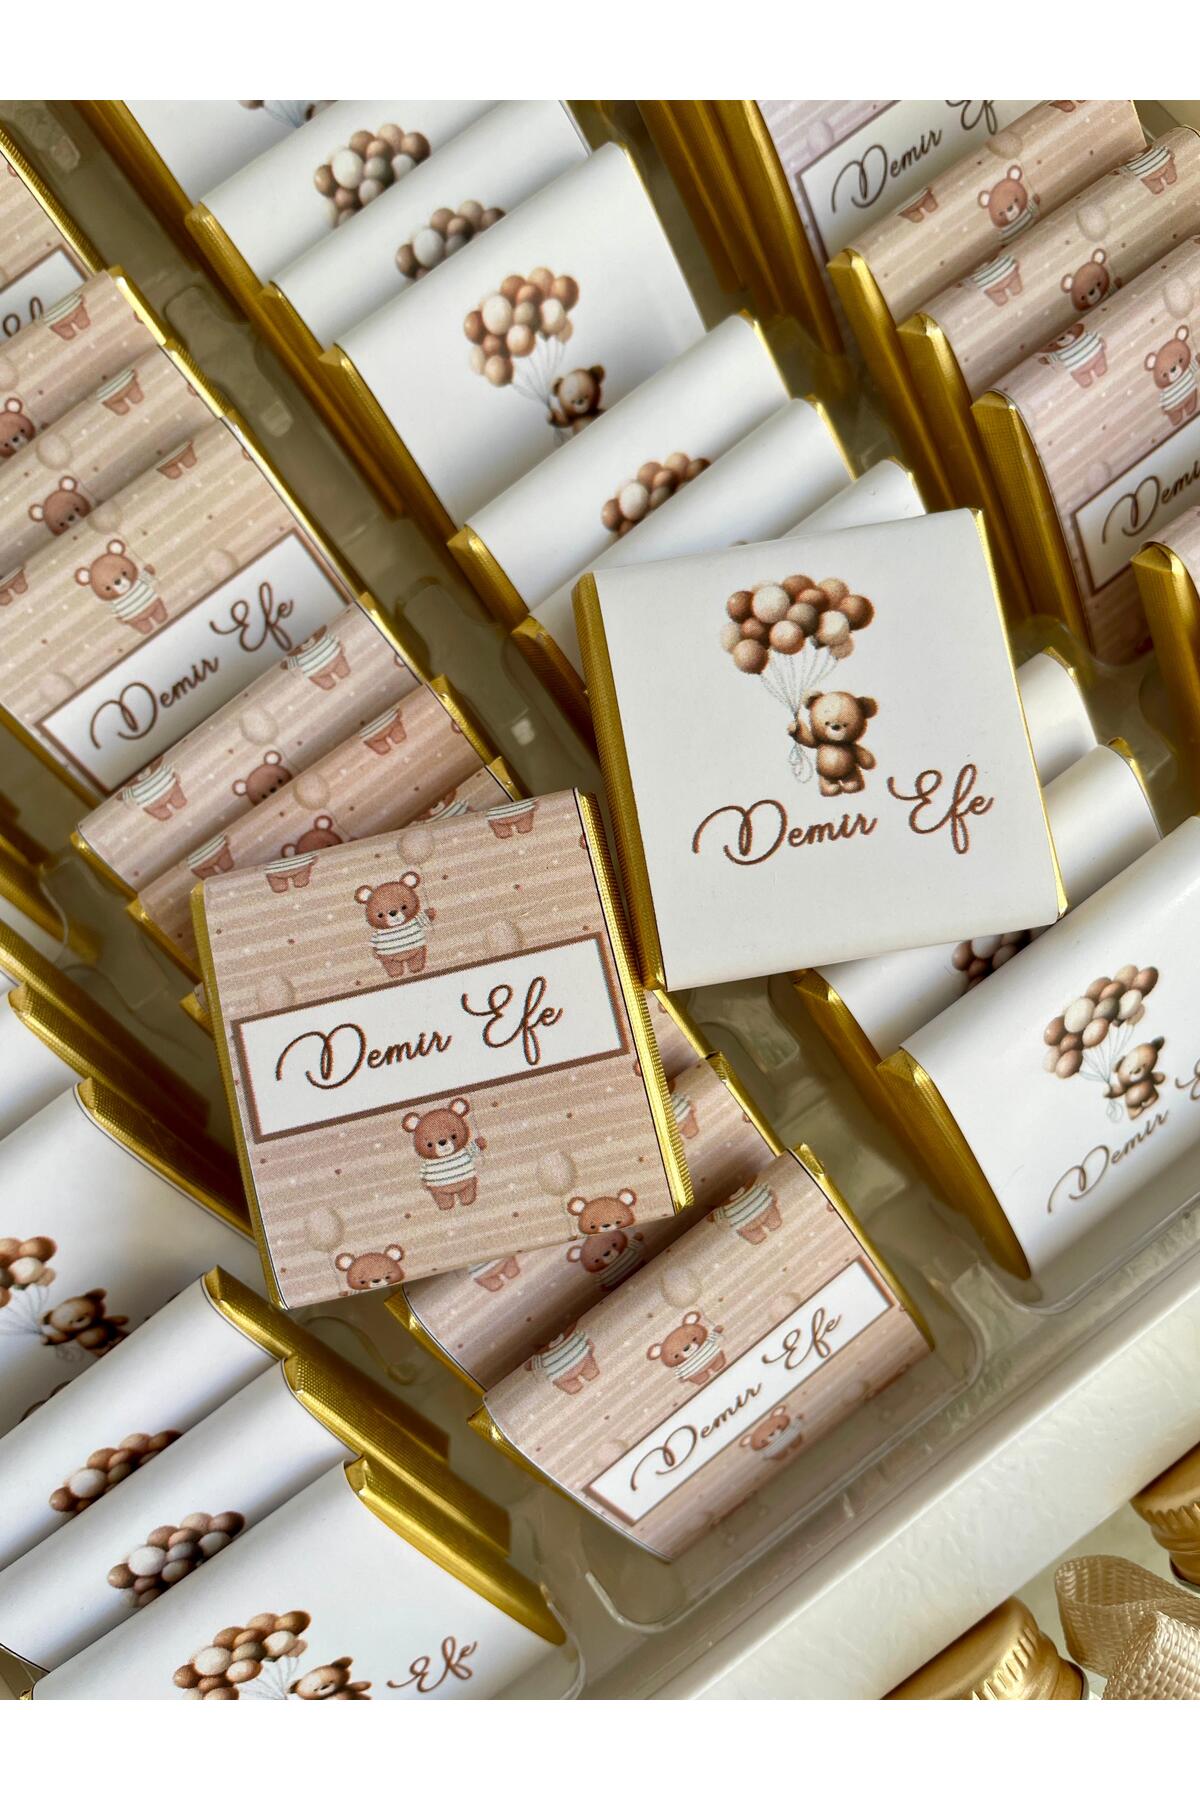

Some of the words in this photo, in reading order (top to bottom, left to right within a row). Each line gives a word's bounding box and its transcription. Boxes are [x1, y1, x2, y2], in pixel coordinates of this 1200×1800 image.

[831, 128, 943, 214] Demir
[1101, 459, 1200, 545] Demi
[89, 656, 219, 750] Demir
[209, 581, 294, 652] Efe
[692, 799, 878, 866] Demir
[886, 763, 995, 855] Efe
[275, 1022, 453, 1090] Demir
[460, 975, 564, 1067] Efe
[1047, 1108, 1170, 1214] Demir
[630, 1382, 763, 1492] Demir
[761, 1306, 842, 1370] Efe
[386, 1635, 478, 1693] Efe
